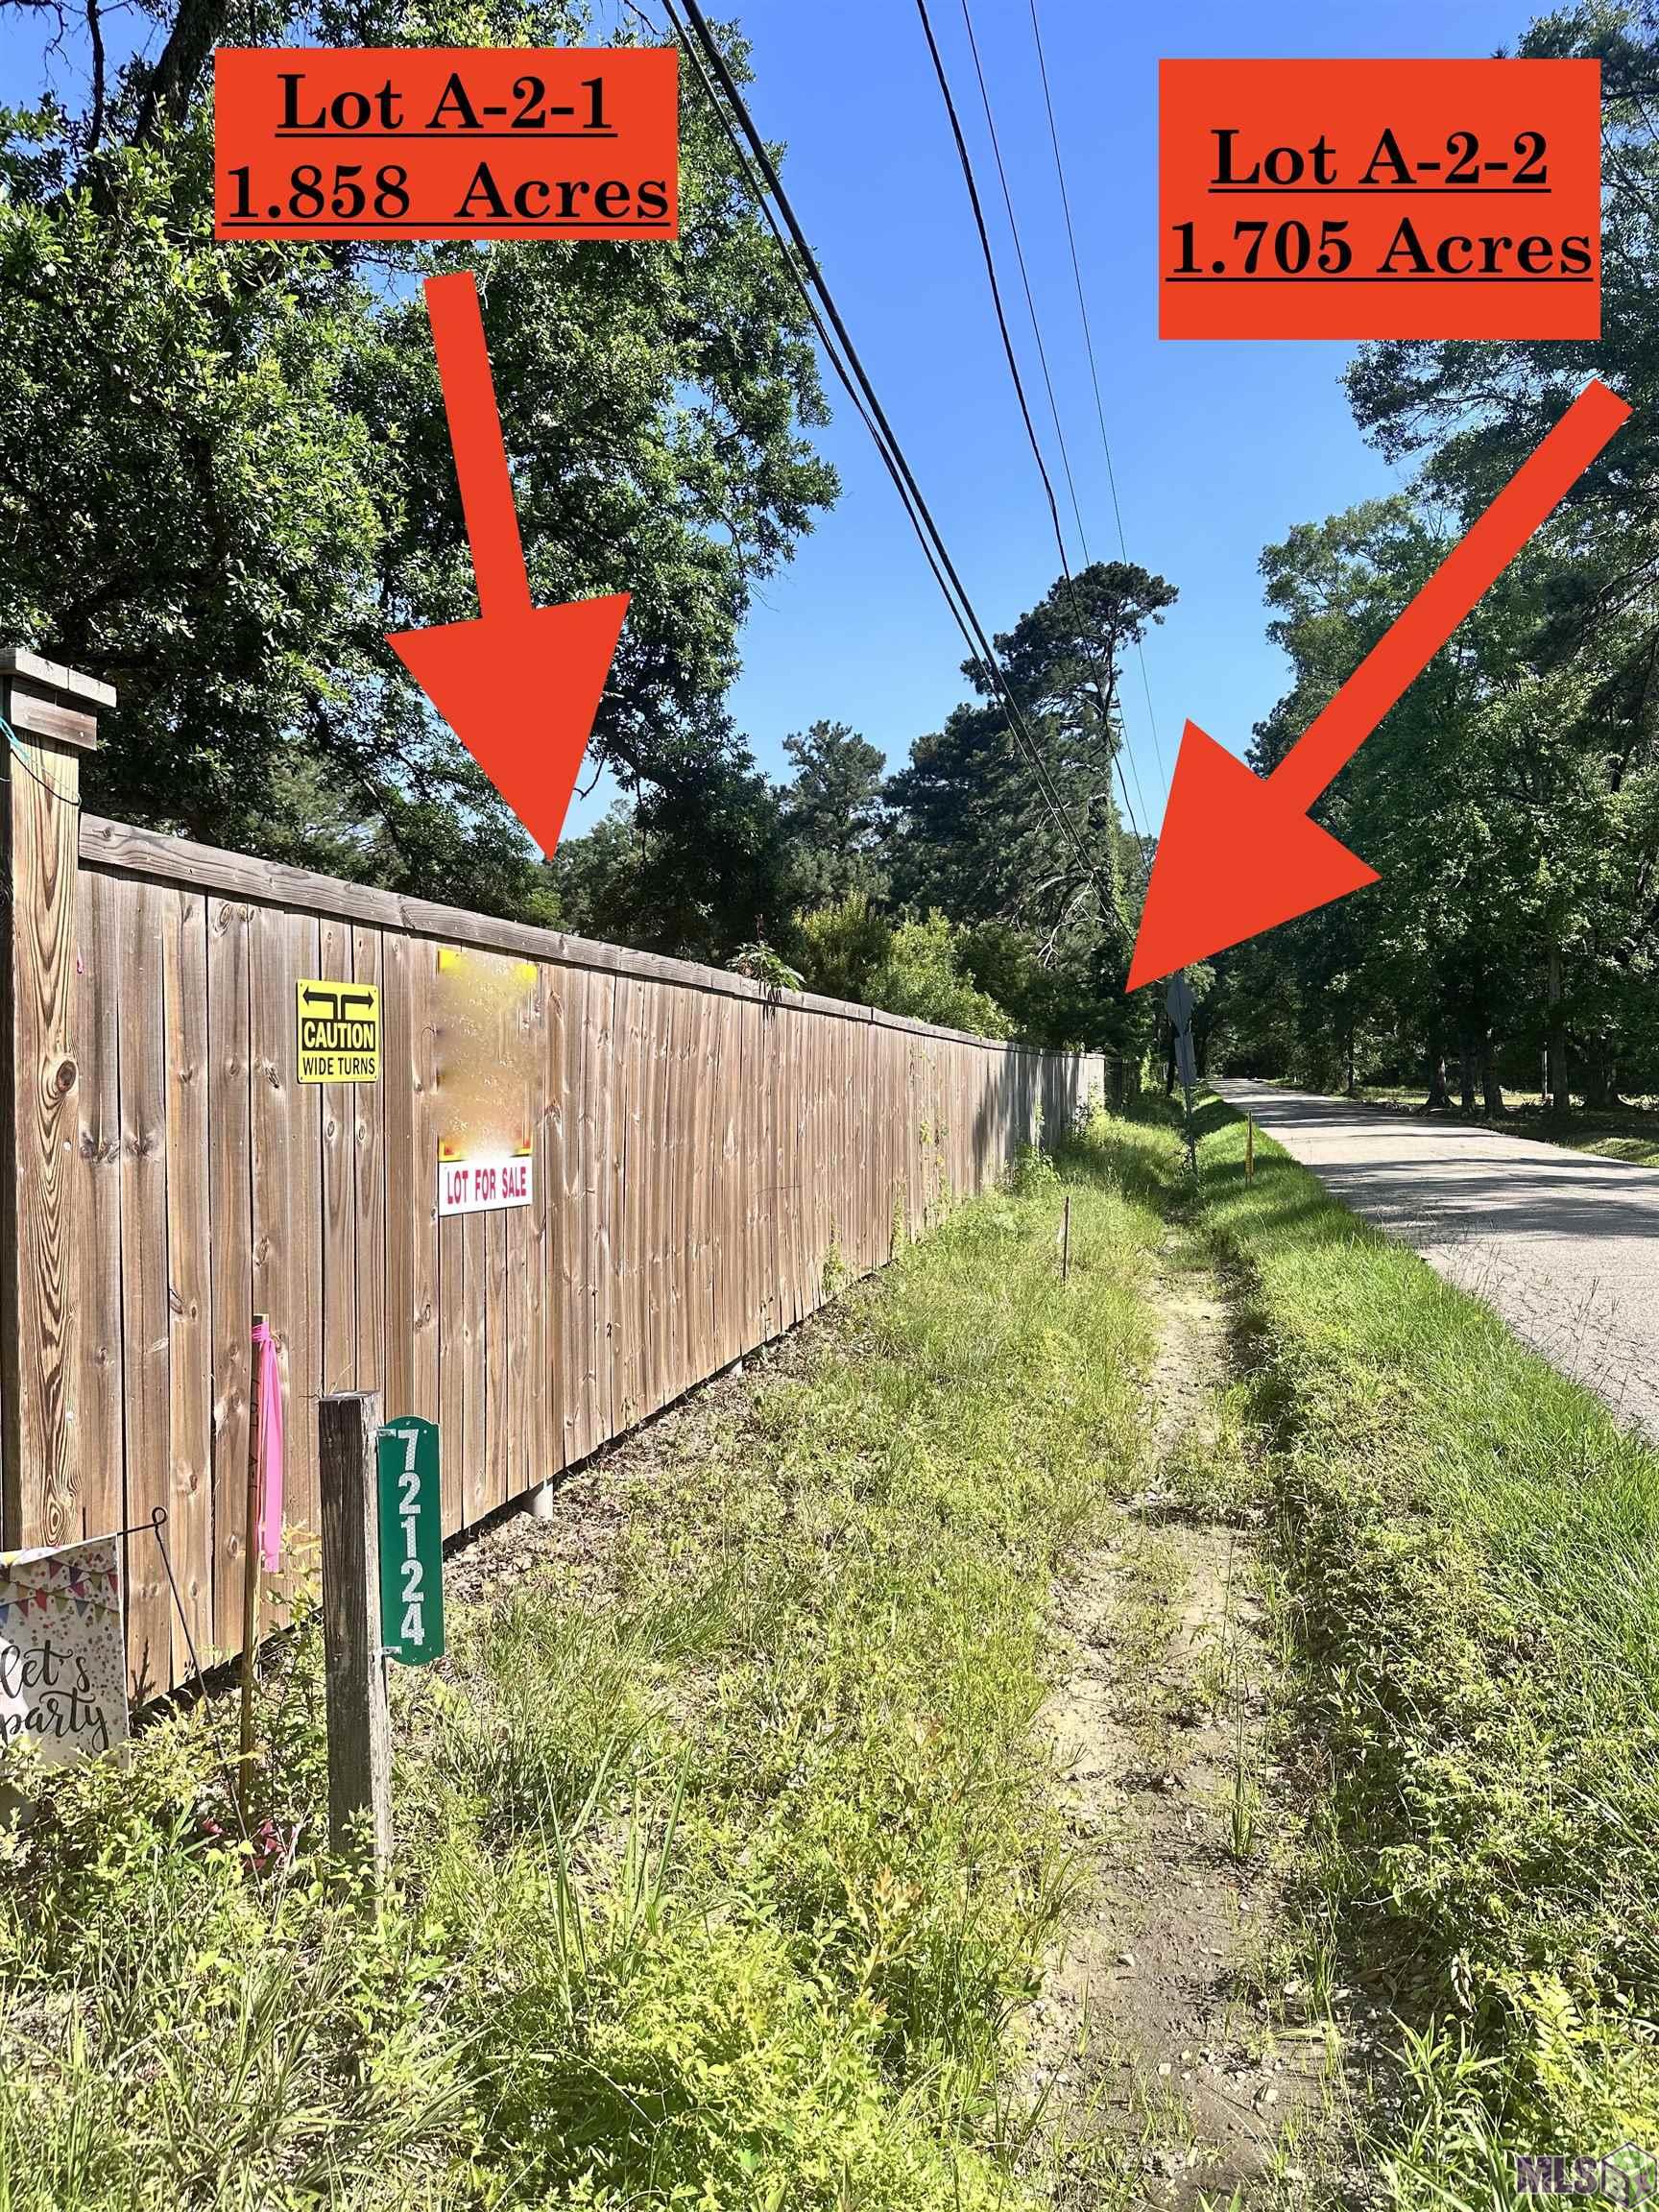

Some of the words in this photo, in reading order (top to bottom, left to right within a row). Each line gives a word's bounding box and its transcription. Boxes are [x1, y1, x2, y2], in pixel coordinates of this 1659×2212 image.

[303, 1021, 374, 1049] CAUTION
[302, 1057, 334, 1075] WIDE
[337, 1057, 375, 1075] TURNS
[447, 1169, 469, 1204] LOT
[474, 1167, 496, 1201] FOR
[502, 1166, 526, 1199] SALE
[397, 1428, 425, 1647] 72124
[0, 1639, 91, 1698] let's
[0, 1687, 109, 1760] party
